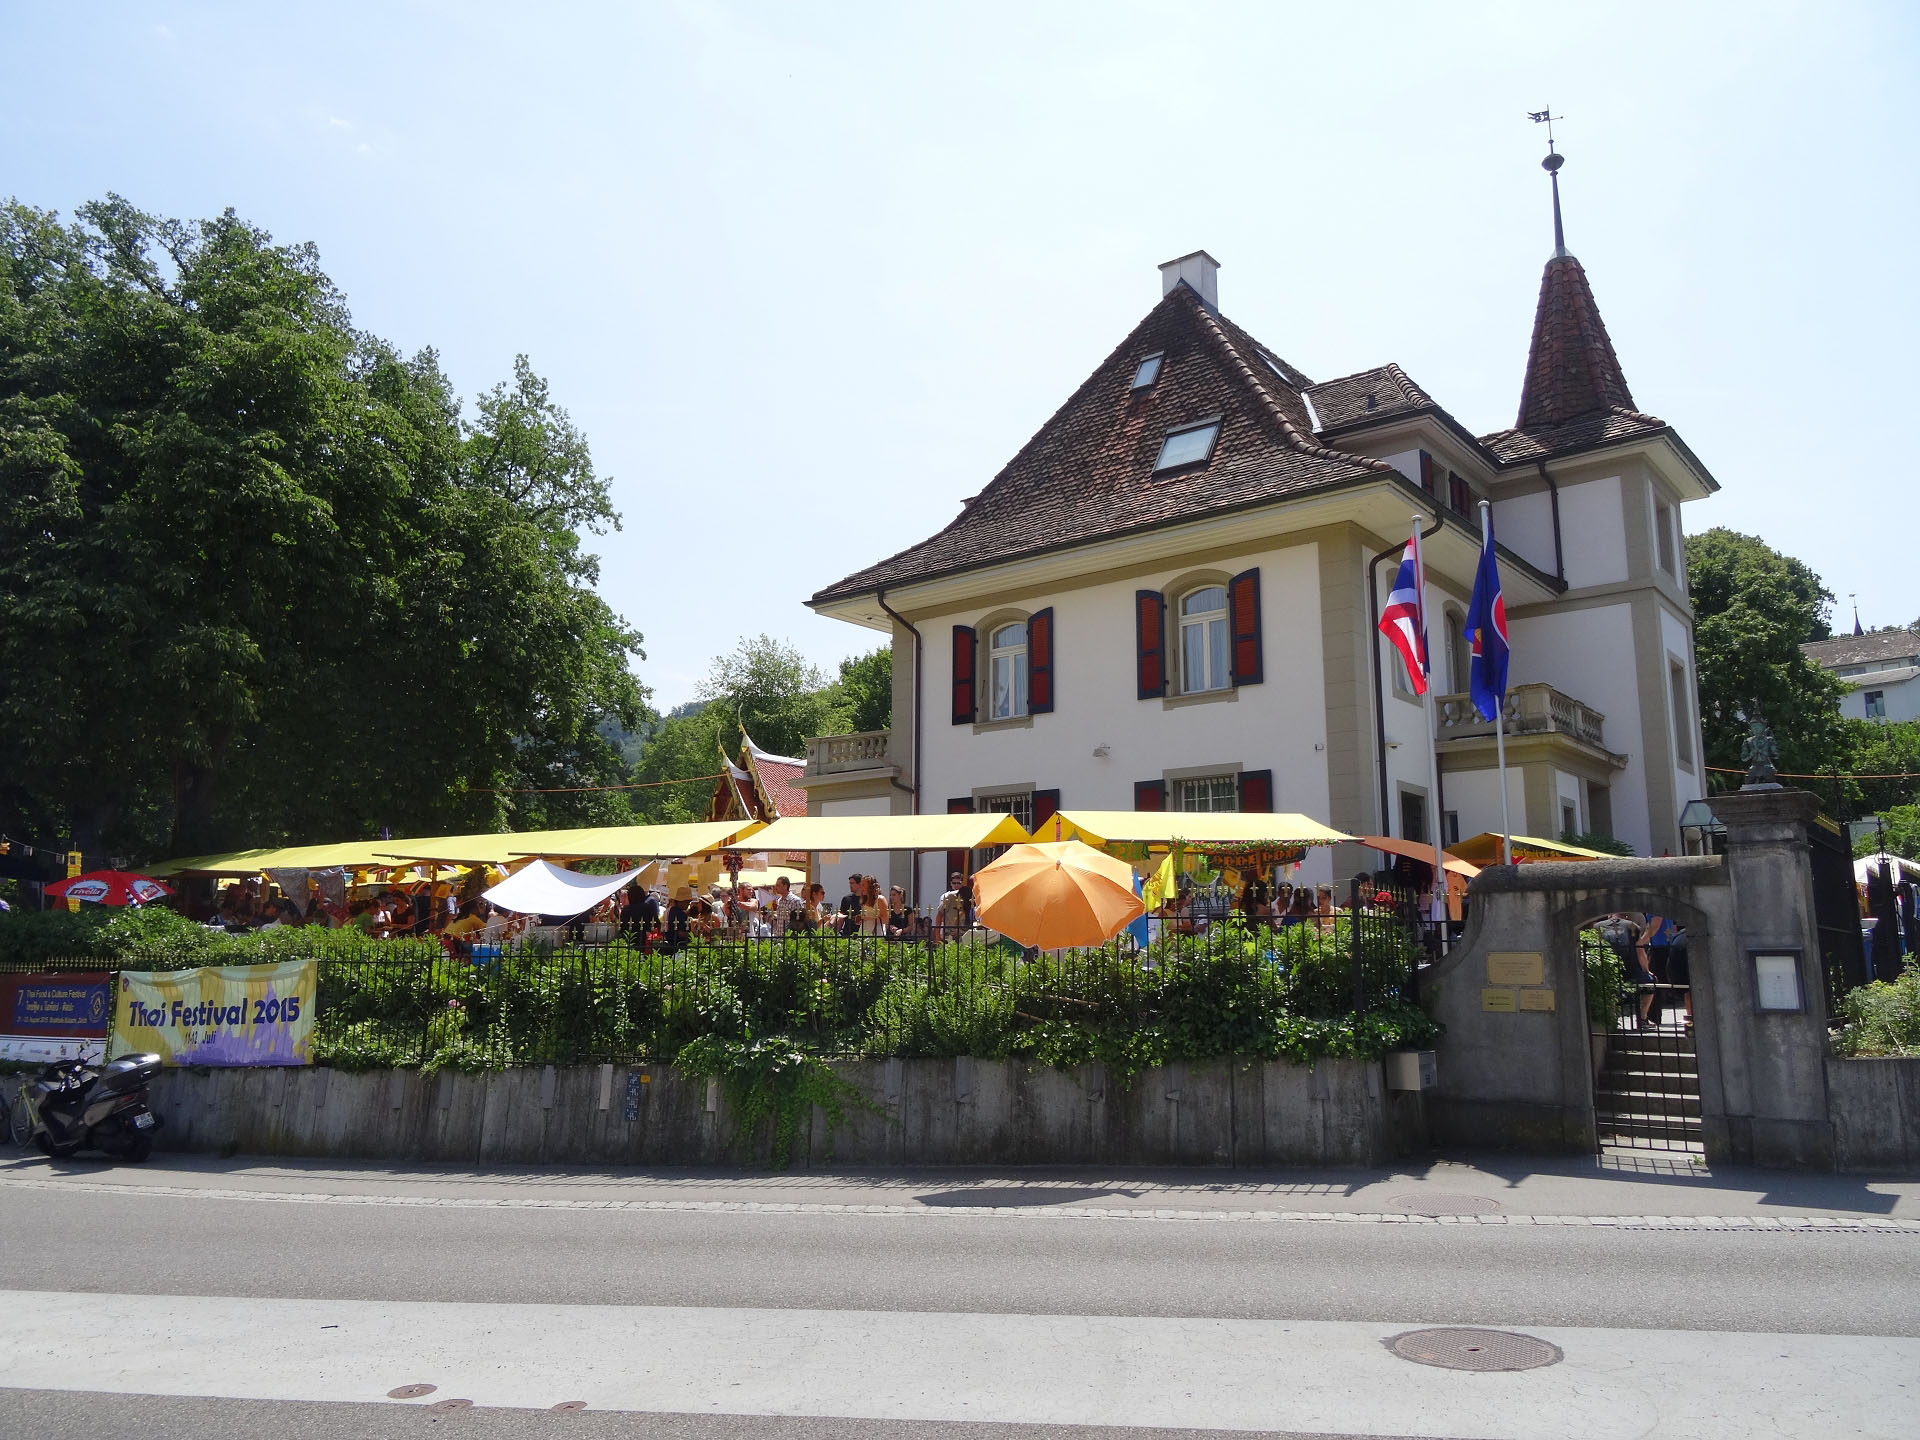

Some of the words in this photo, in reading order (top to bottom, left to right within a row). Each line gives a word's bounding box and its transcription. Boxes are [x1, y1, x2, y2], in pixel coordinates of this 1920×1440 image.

[69, 989, 87, 998] Festival
[129, 1001, 166, 1027] Thai
[171, 998, 248, 1027] Festival
[253, 997, 300, 1025] 2015
[202, 1030, 217, 1045] Juli
